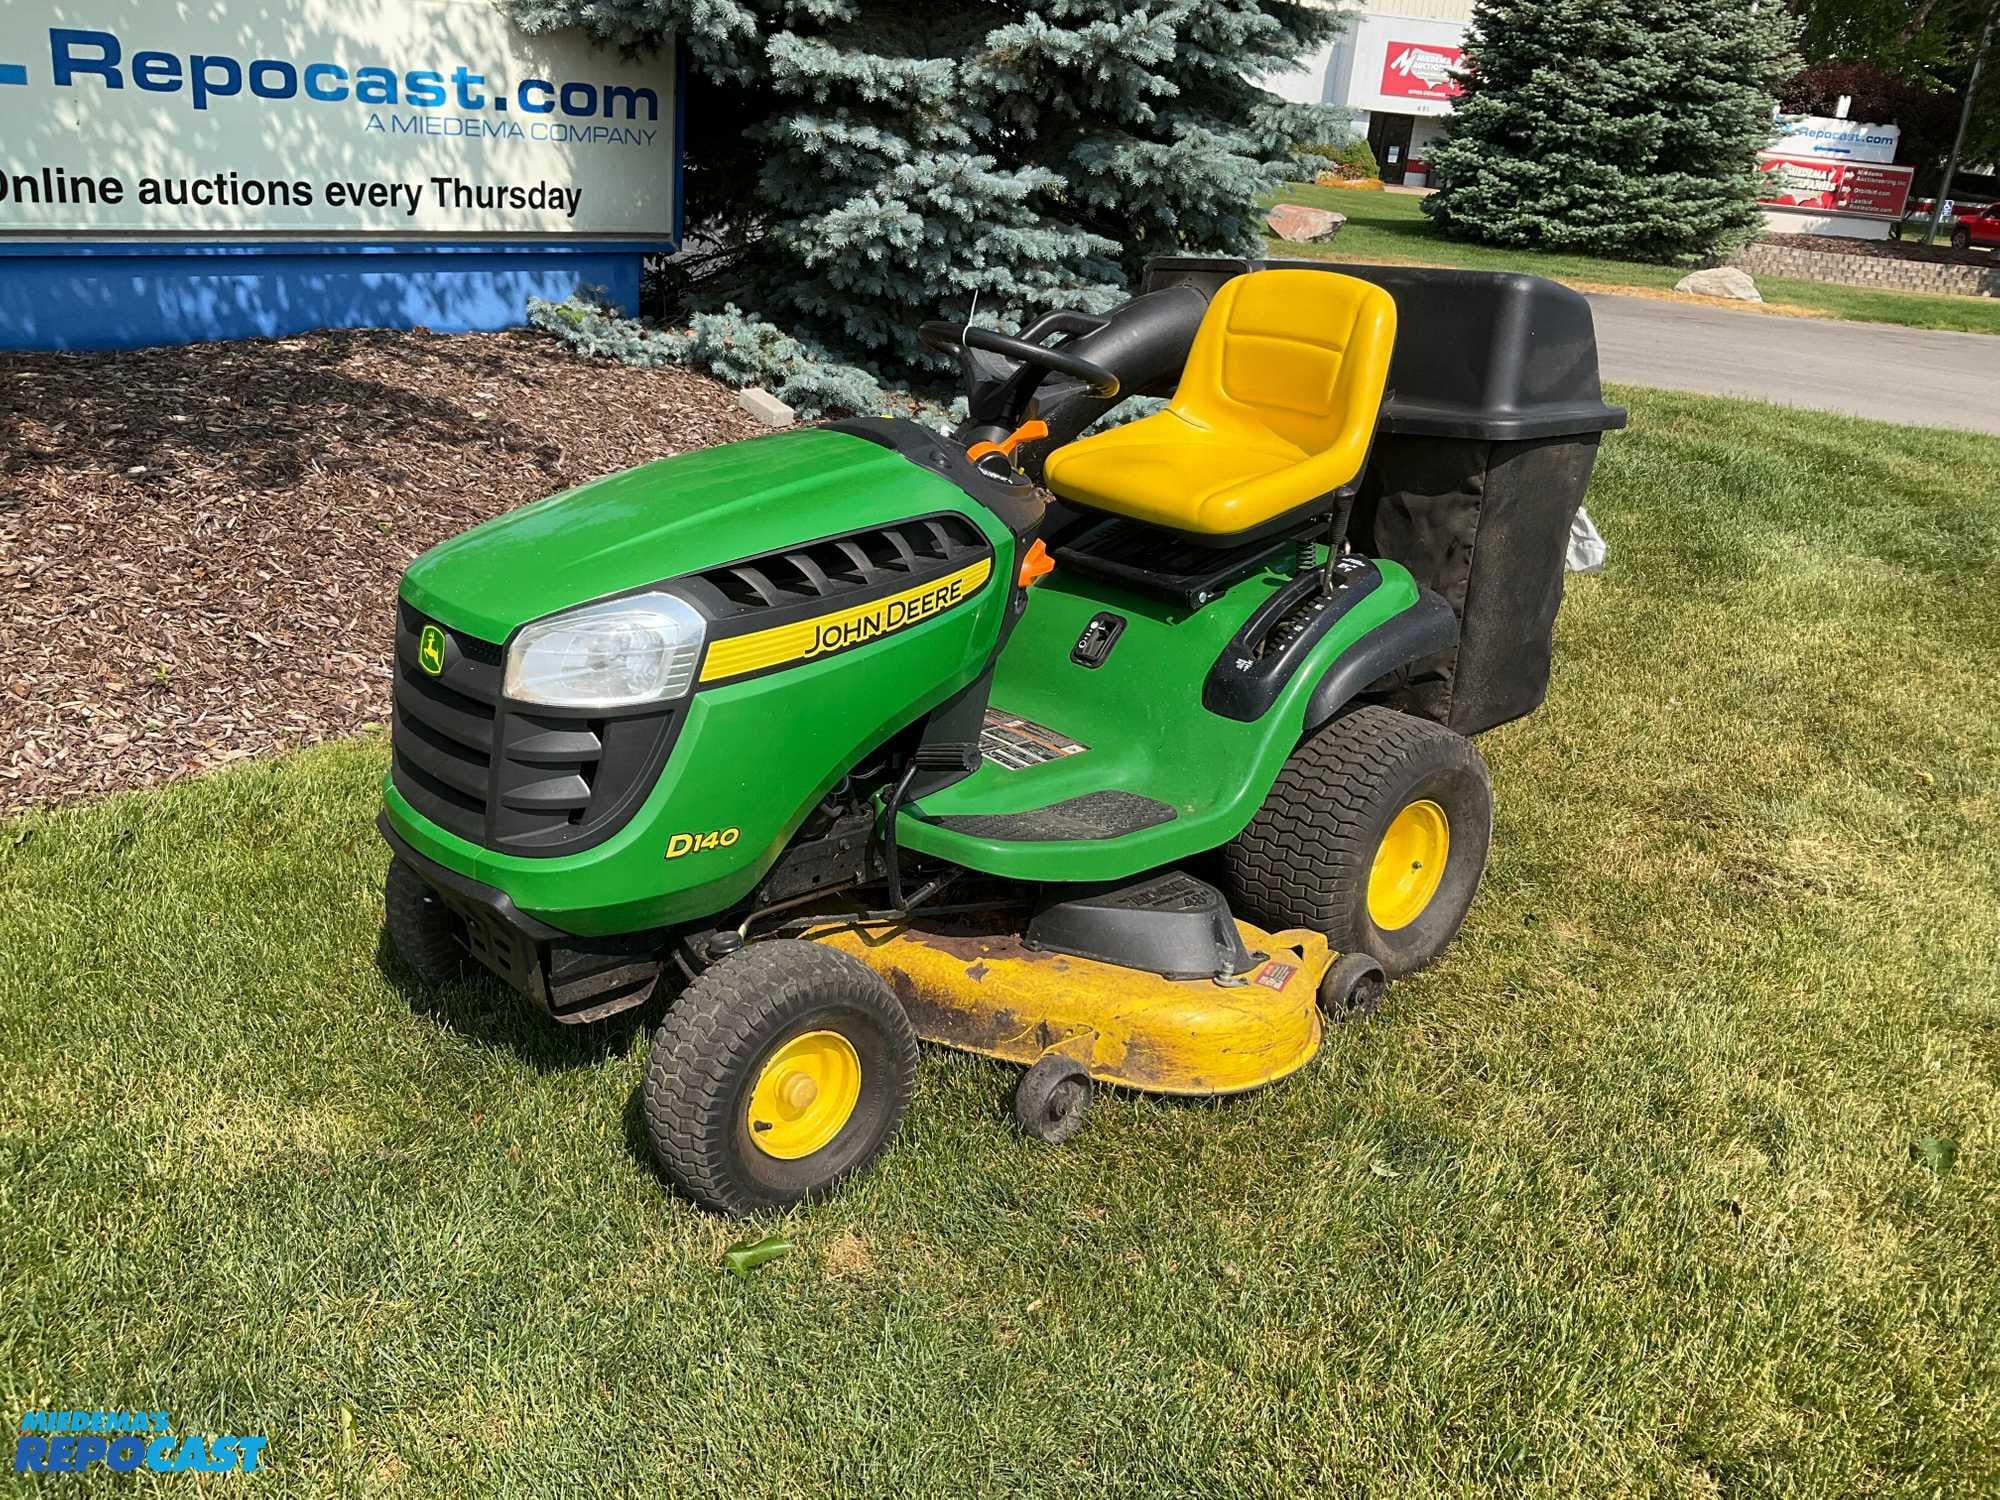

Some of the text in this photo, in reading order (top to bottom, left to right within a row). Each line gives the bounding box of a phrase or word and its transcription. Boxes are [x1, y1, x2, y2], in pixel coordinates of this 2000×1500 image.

[49, 27, 659, 121] Repocast.com
[365, 113, 657, 145] A MIEDEMA COMPANY
[1800, 126, 1893, 145] Repocast.com
[0, 167, 582, 217] nline auctions every Thursday
[804, 578, 963, 656] JOHN DEERE
[665, 828, 741, 861] D140
